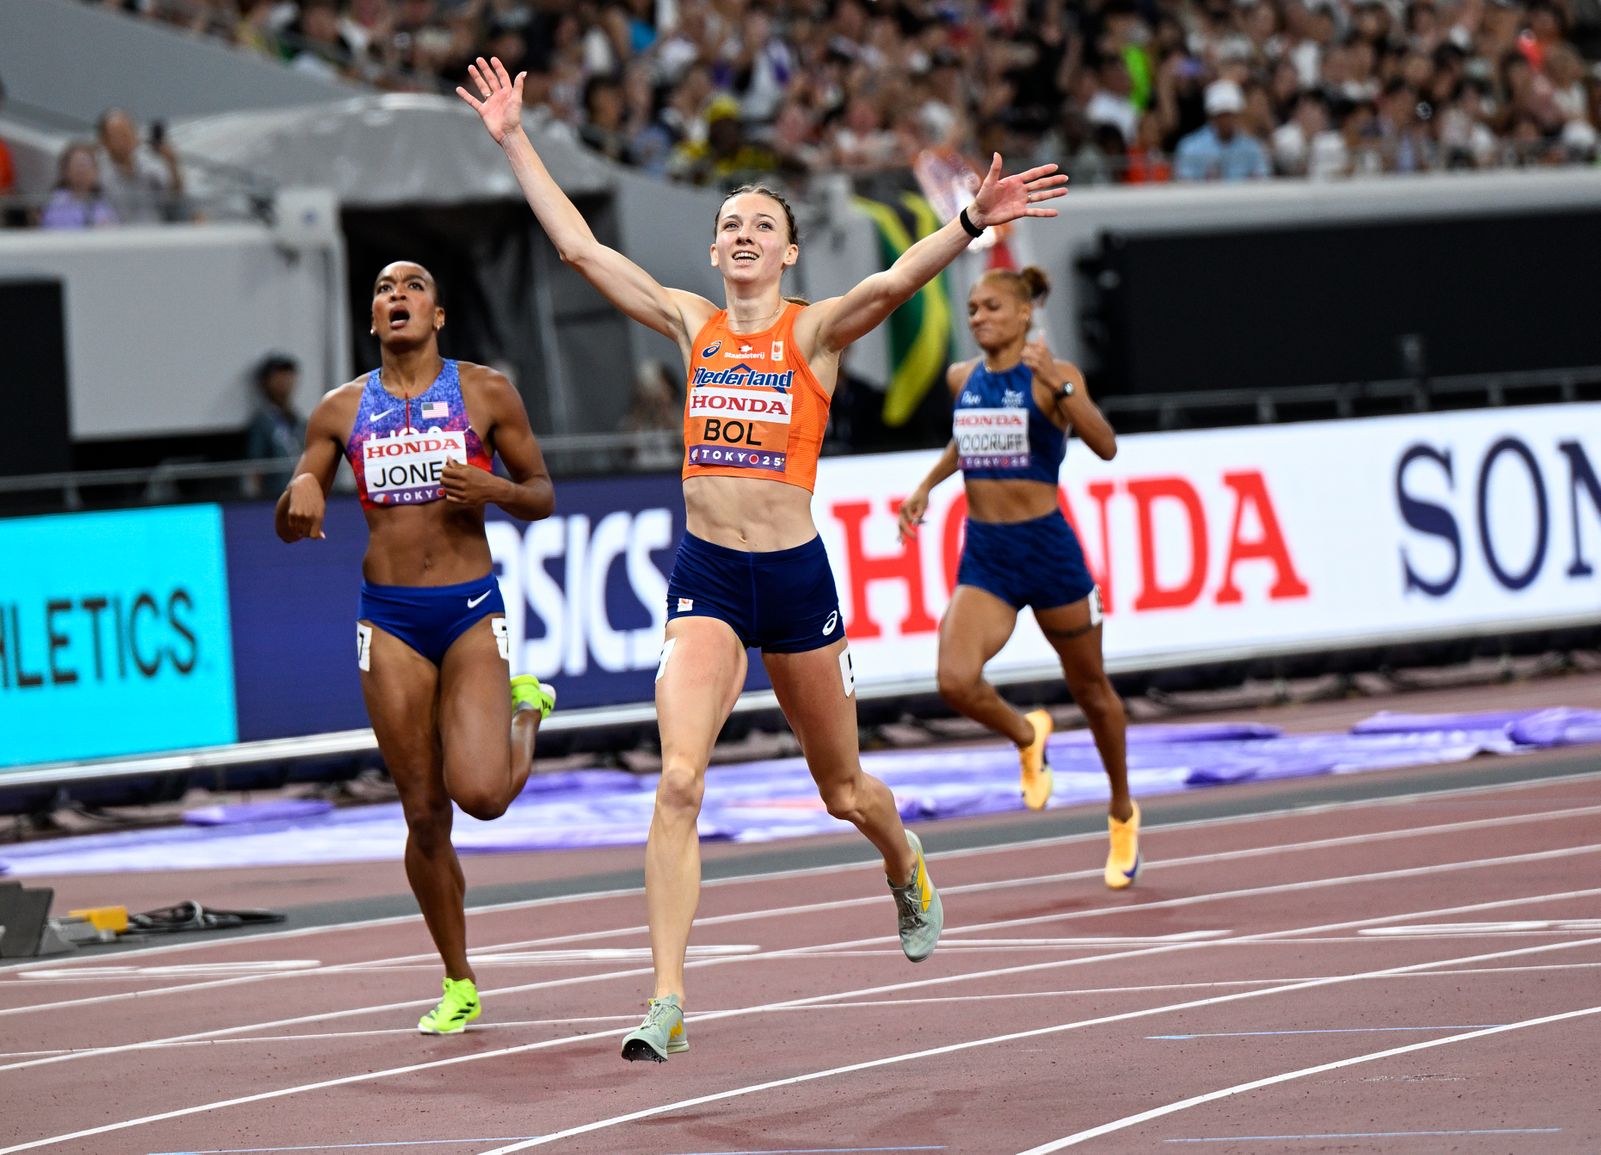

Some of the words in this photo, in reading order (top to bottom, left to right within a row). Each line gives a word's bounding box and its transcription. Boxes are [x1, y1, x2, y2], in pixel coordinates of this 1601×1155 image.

[724, 351, 765, 360] Staatsloterij
[691, 395, 789, 415] HONDA
[956, 414, 1023, 427] HONDA
[703, 418, 762, 446] BOL
[366, 438, 462, 459] HONDA
[373, 460, 457, 489] JONE
